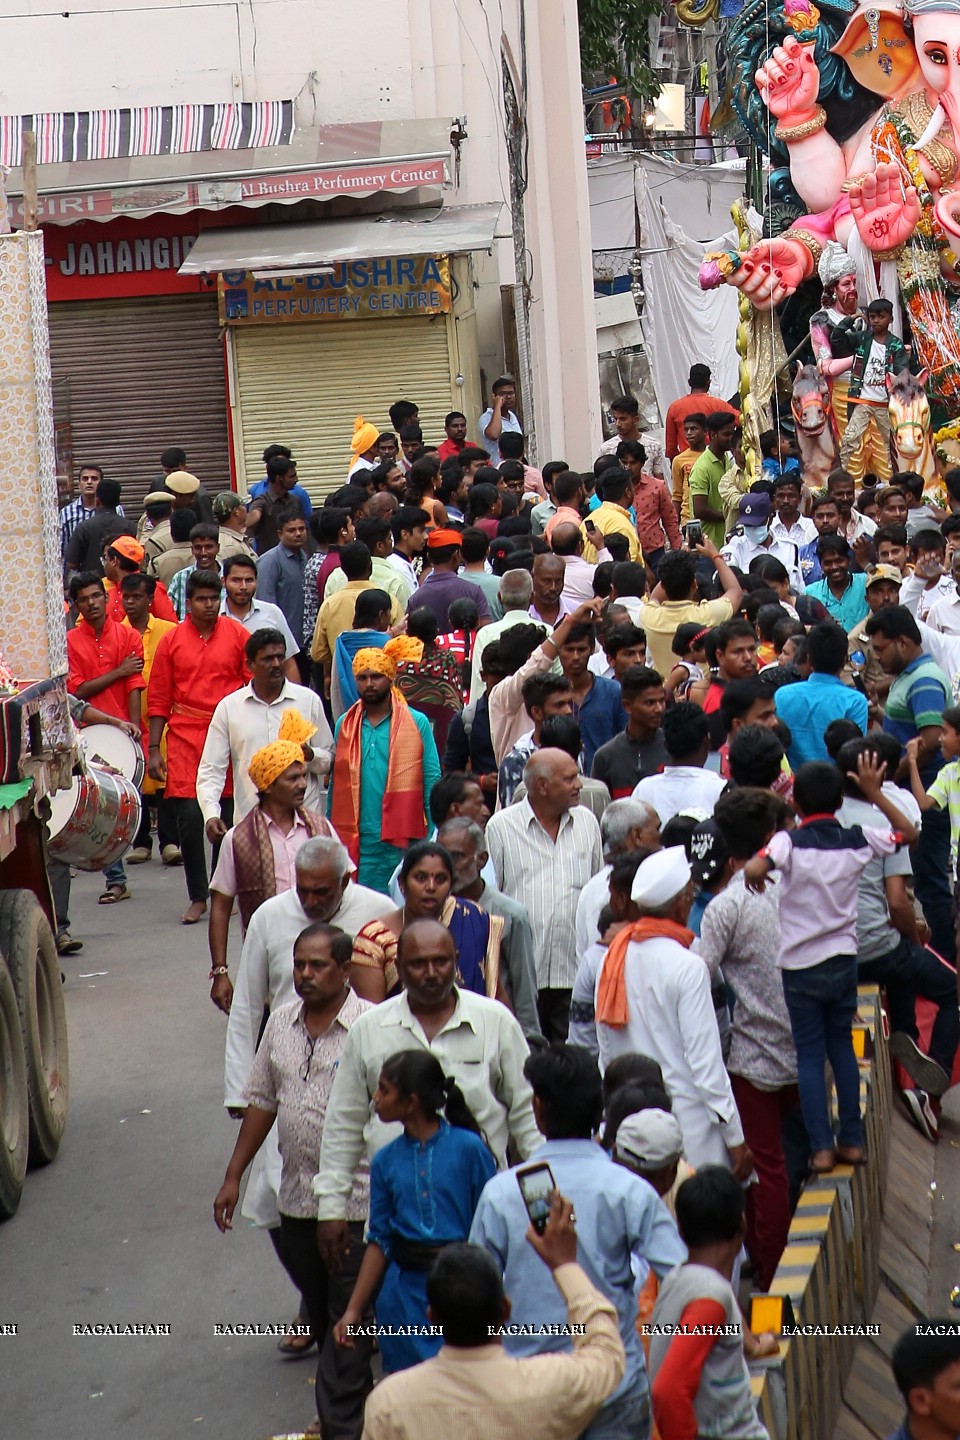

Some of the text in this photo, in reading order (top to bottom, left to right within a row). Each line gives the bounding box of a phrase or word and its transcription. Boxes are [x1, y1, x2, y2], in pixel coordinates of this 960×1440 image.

[259, 181, 310, 196] Bushra
[314, 173, 387, 191] Perfumery
[390, 168, 439, 184] Center
[253, 291, 441, 317] PERFUMERY CENTRE
